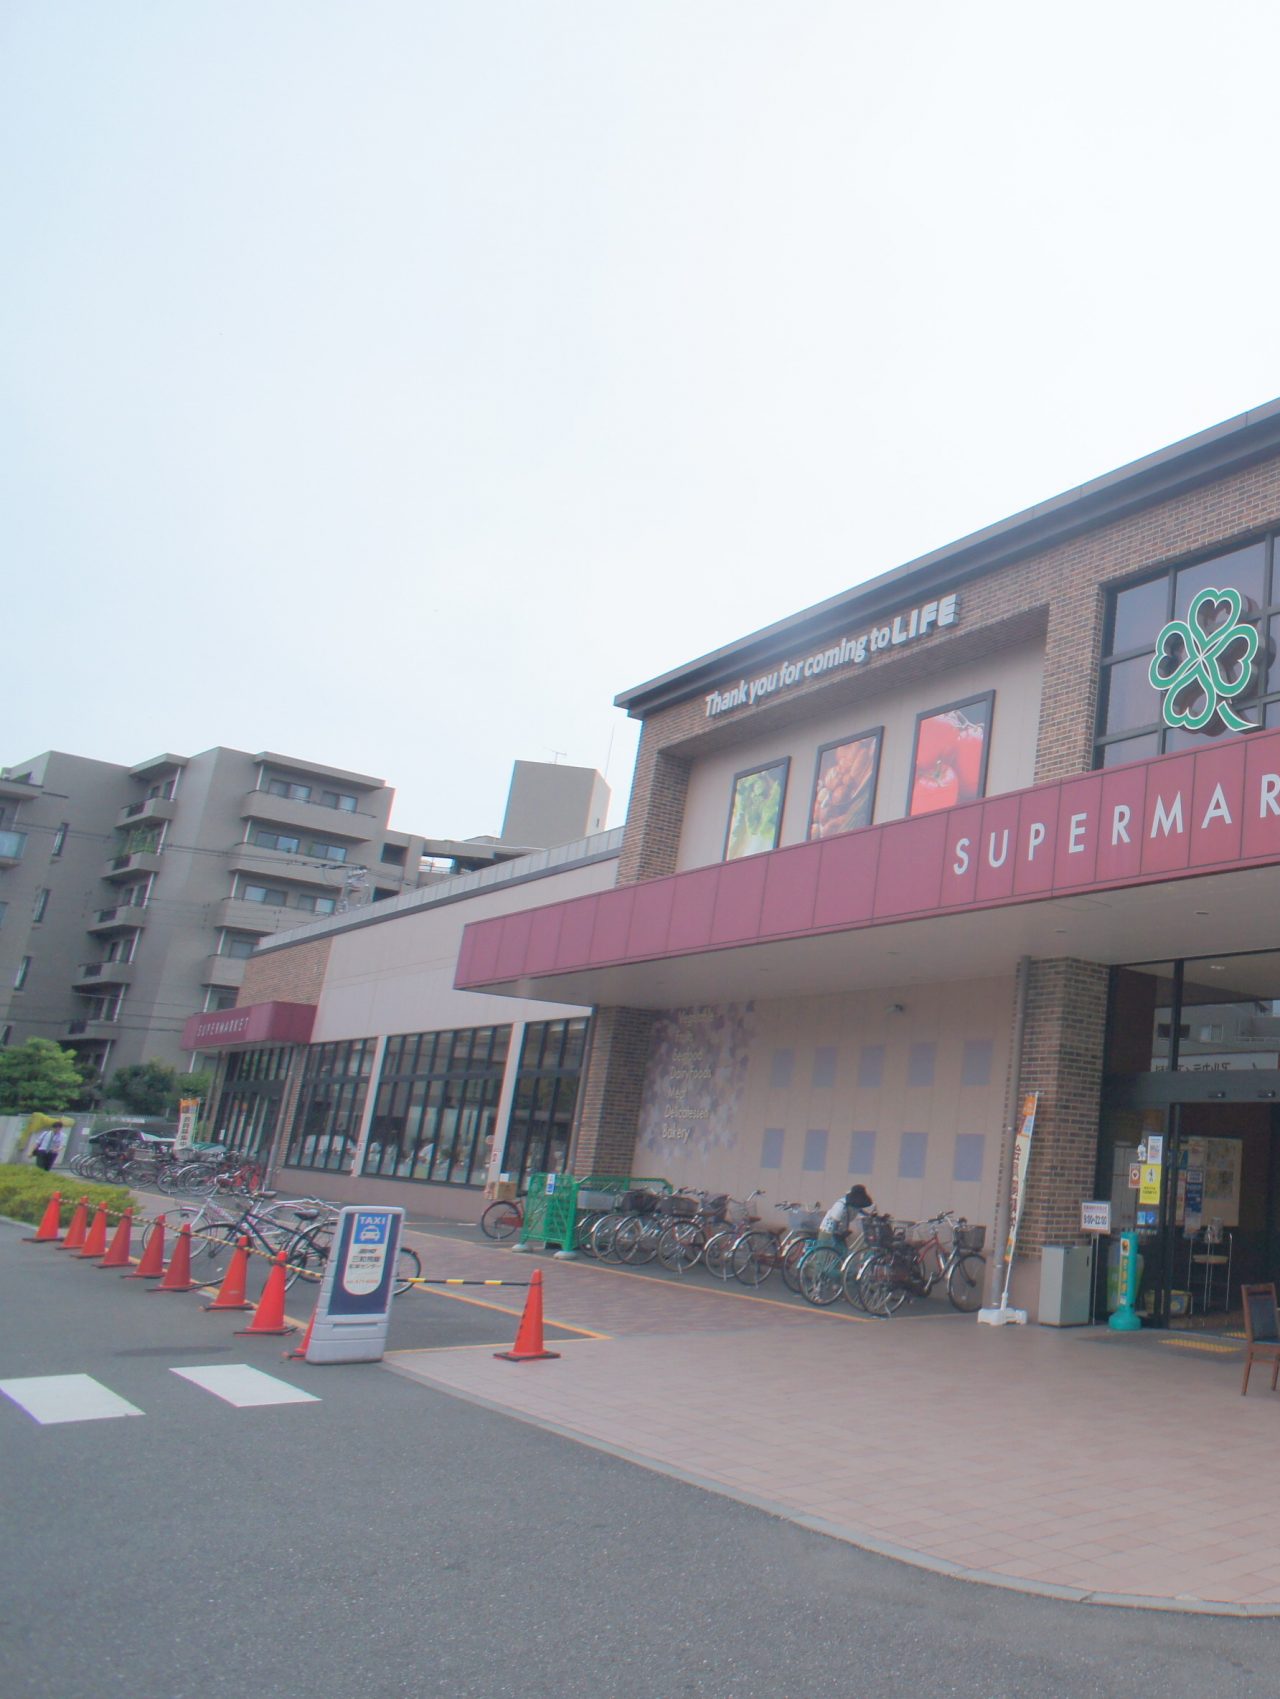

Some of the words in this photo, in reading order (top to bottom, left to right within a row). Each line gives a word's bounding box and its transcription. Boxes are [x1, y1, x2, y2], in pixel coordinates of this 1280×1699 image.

[705, 681, 748, 719] Thank
[749, 669, 778, 706] you
[778, 658, 804, 689] for
[804, 636, 868, 676] coming
[869, 627, 891, 652] to
[891, 593, 961, 645] LIFE
[197, 1016, 250, 1037] SUPERMARKET
[662, 1122, 692, 1144] Bakery
[359, 1215, 386, 1226] TAXI
